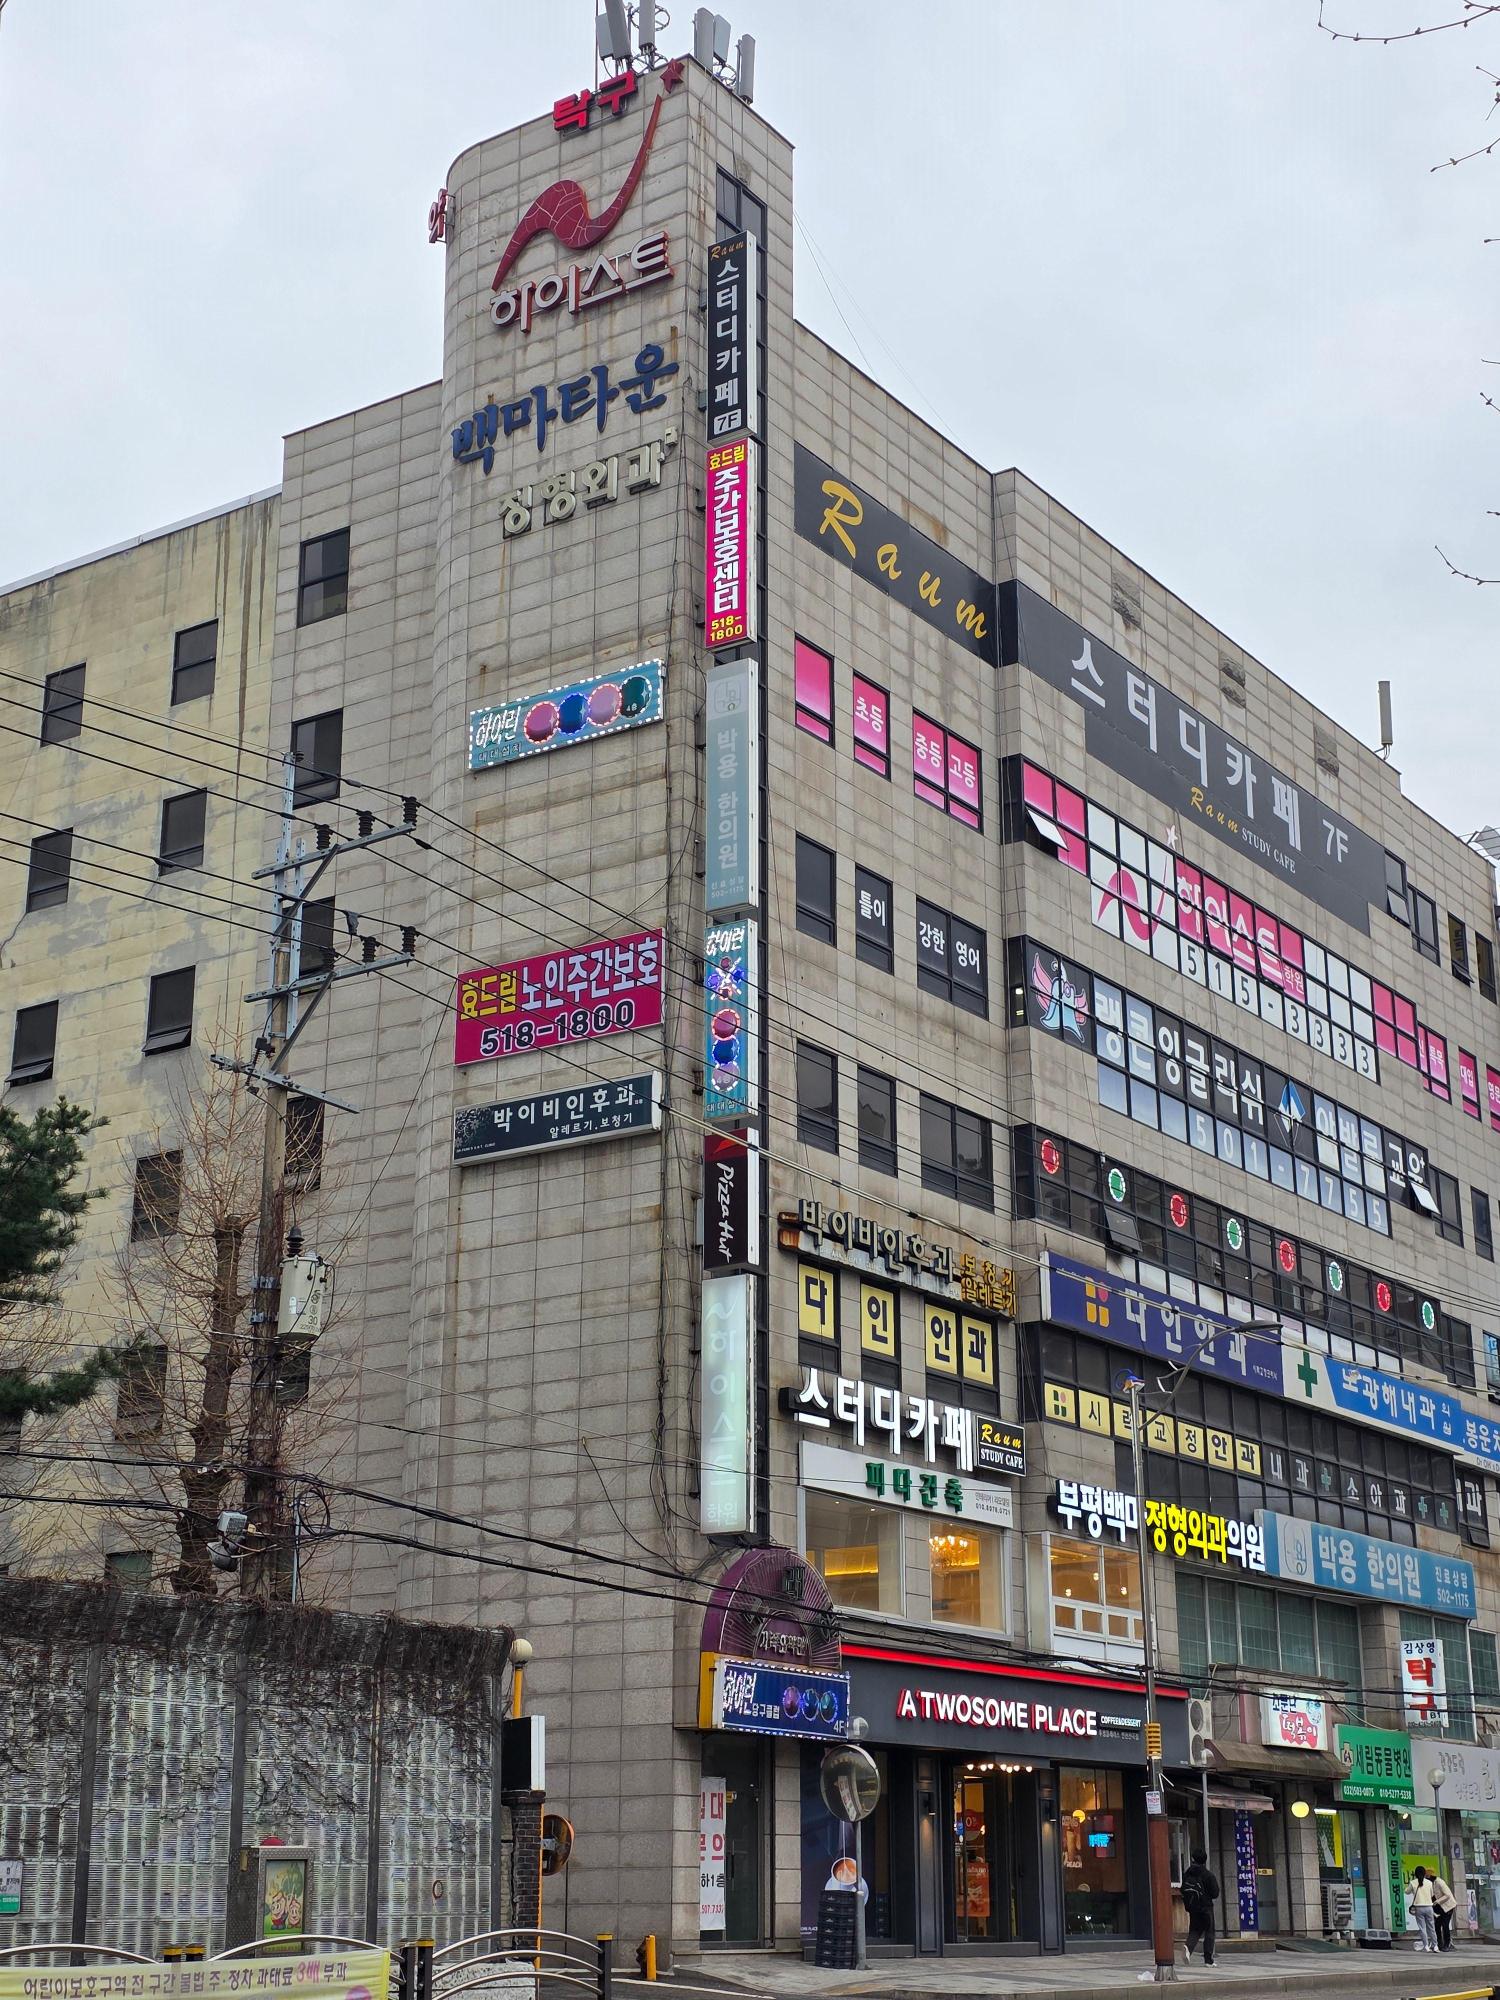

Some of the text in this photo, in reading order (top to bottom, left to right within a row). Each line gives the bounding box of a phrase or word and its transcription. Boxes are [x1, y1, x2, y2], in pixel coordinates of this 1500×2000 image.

[553, 71, 638, 131] 탁구
[490, 231, 674, 333] 하이스트
[710, 242, 745, 261] Raum
[714, 259, 742, 407] 스터디카페
[451, 343, 679, 475] 백마타운
[714, 409, 742, 435] 7F
[499, 437, 666, 537] 정형외과
[709, 444, 745, 471] 효드림
[713, 466, 742, 614] 주간보호센터
[819, 479, 987, 639] Raum
[710, 624, 743, 642] 1800
[855, 696, 884, 733] 초등
[915, 732, 976, 790] 중등 고등
[1071, 637, 1349, 864] 스터디카페 7F
[717, 791, 738, 870] 한의원
[1190, 786, 1296, 874] Raum STUDY CAFE
[919, 921, 980, 974] 강한 영어
[1177, 874, 1304, 992] 하이스트 학원
[460, 937, 659, 1020] 효드림 노인주간보호
[1187, 946, 1371, 1075] 515-3333
[480, 999, 635, 1056] 518-1800
[493, 1084, 635, 1133] 박이비인후과
[1195, 1114, 1382, 1227] 501-7755
[716, 1162, 735, 1264] Pizza Hut
[799, 1199, 954, 1283] 박이비인후과
[961, 1278, 1018, 1317] 알레르기
[1124, 1287, 1248, 1376] 다인안과
[709, 1329, 737, 1487] 하이스트
[794, 1368, 973, 1472] 스터디카페
[981, 1423, 1022, 1448] Raum
[980, 1448, 1023, 1470] STUDY CAFE
[1269, 1451, 1310, 1488] 내과
[1346, 1476, 1407, 1516] 소아과
[1318, 1534, 1422, 1599] 박용 한의원
[1436, 1587, 1470, 1608] 502-1175
[1403, 1642, 1437, 1655] 김상영
[896, 1689, 1098, 1737] A TWOSOME PLACE
[1405, 1657, 1438, 1721] 탁구
[1355, 1744, 1412, 1779] 세림동물병원
[1388, 1836, 1403, 1928] 동물병원
[23, 1975, 128, 2000] 어린이보호구역
[131, 1974, 145, 1996] 전
[148, 1973, 175, 1995] 구간
[179, 1971, 205, 1993] 불법
[257, 1967, 294, 1988] 과태료
[296, 1961, 321, 1984] 3배
[323, 1962, 348, 1982] 부과
